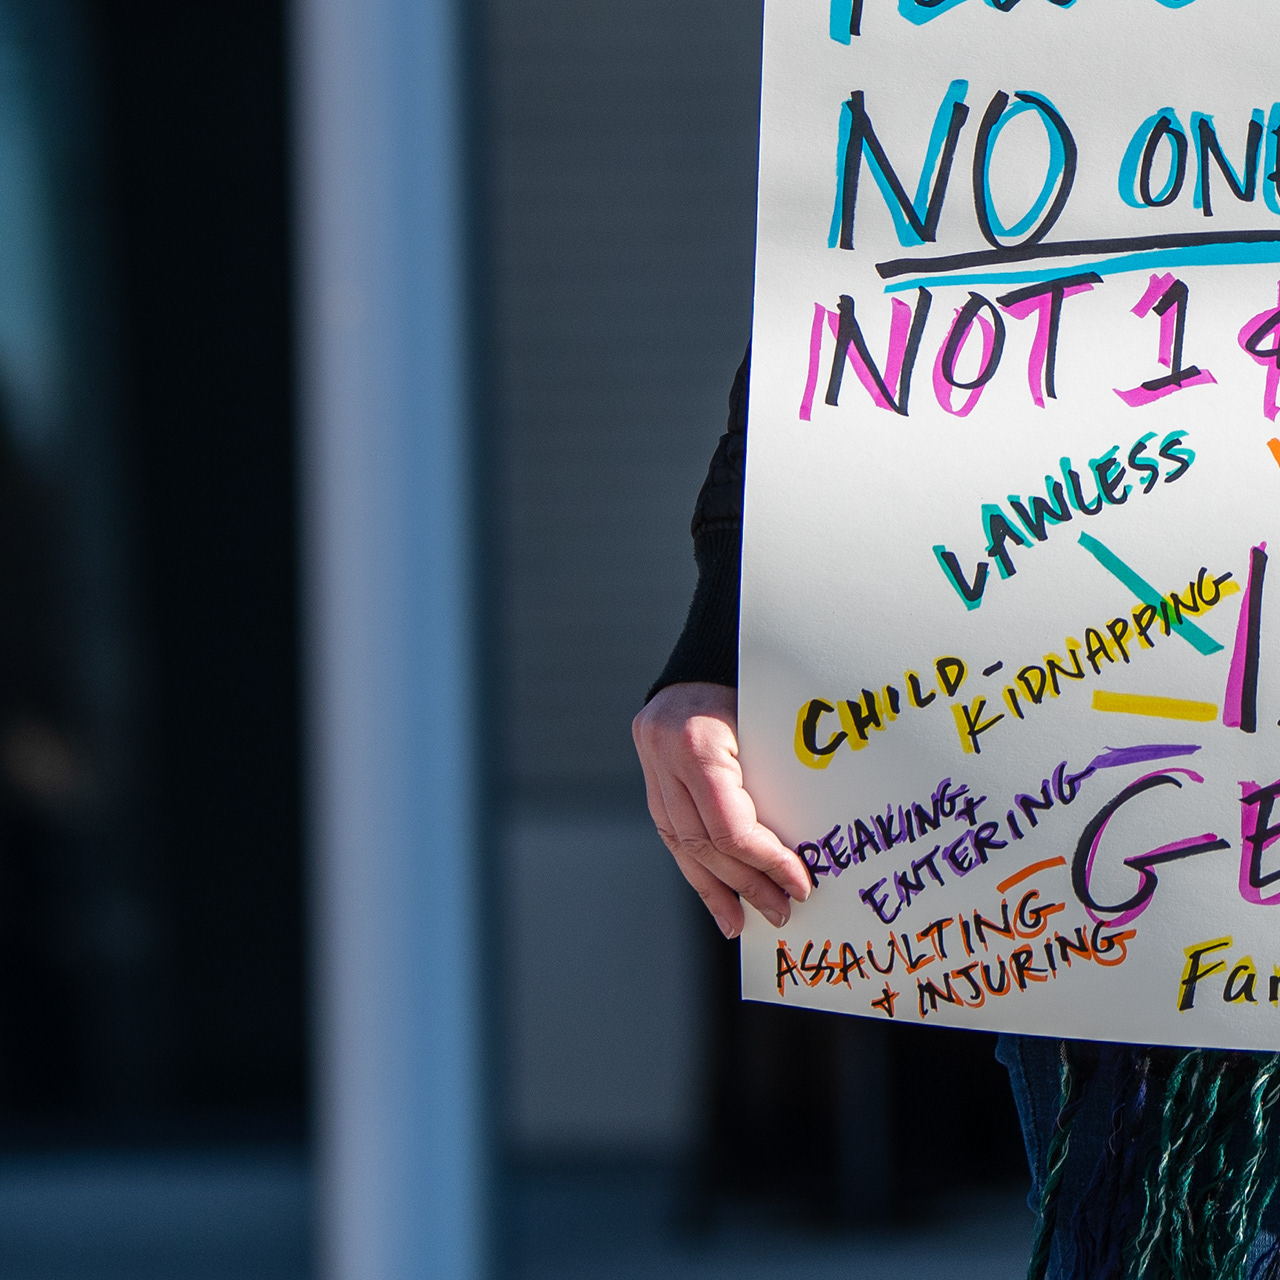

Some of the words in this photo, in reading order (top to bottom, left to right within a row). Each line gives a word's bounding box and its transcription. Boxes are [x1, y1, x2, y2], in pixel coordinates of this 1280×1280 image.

[827, 79, 1077, 251] NO
[799, 272, 1104, 421] NOT
[1113, 272, 1218, 408] 1
[932, 430, 1195, 610] LAWLESS
[952, 566, 1241, 754] KIDNAPPING
[790, 777, 970, 890] REAKING
[859, 761, 1096, 924] ENTERING
[776, 889, 1066, 996] ASSAULTING
[917, 920, 1137, 1019] INJURING
